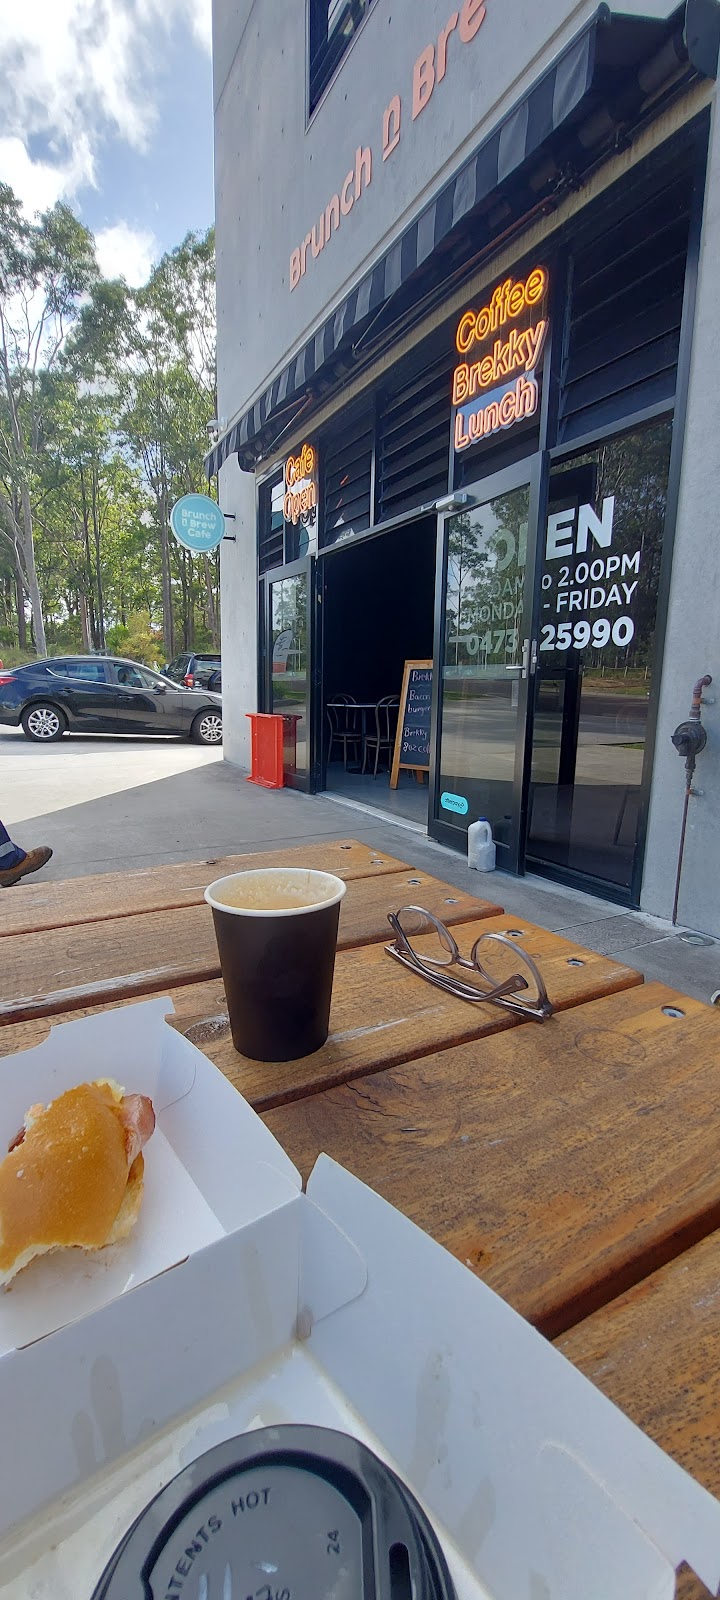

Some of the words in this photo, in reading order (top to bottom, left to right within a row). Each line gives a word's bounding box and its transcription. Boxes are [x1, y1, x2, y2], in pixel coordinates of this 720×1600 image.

[289, 145, 372, 292] Brunch
[456, 268, 546, 354] Coffee
[452, 319, 547, 406] Brekky
[454, 376, 538, 450] Lunch
[285, 442, 314, 487] Cafe
[181, 508, 217, 521] Brunch
[283, 481, 317, 526] Open
[187, 528, 212, 539] Cafe
[190, 519, 216, 530] Brew
[557, 550, 641, 588] 2.00PM
[467, 599, 524, 623] MONDA
[556, 580, 639, 613] FRIDAY
[539, 616, 635, 651] 25990
[407, 703, 431, 716] burger
[231, 1487, 271, 1517] HOT
